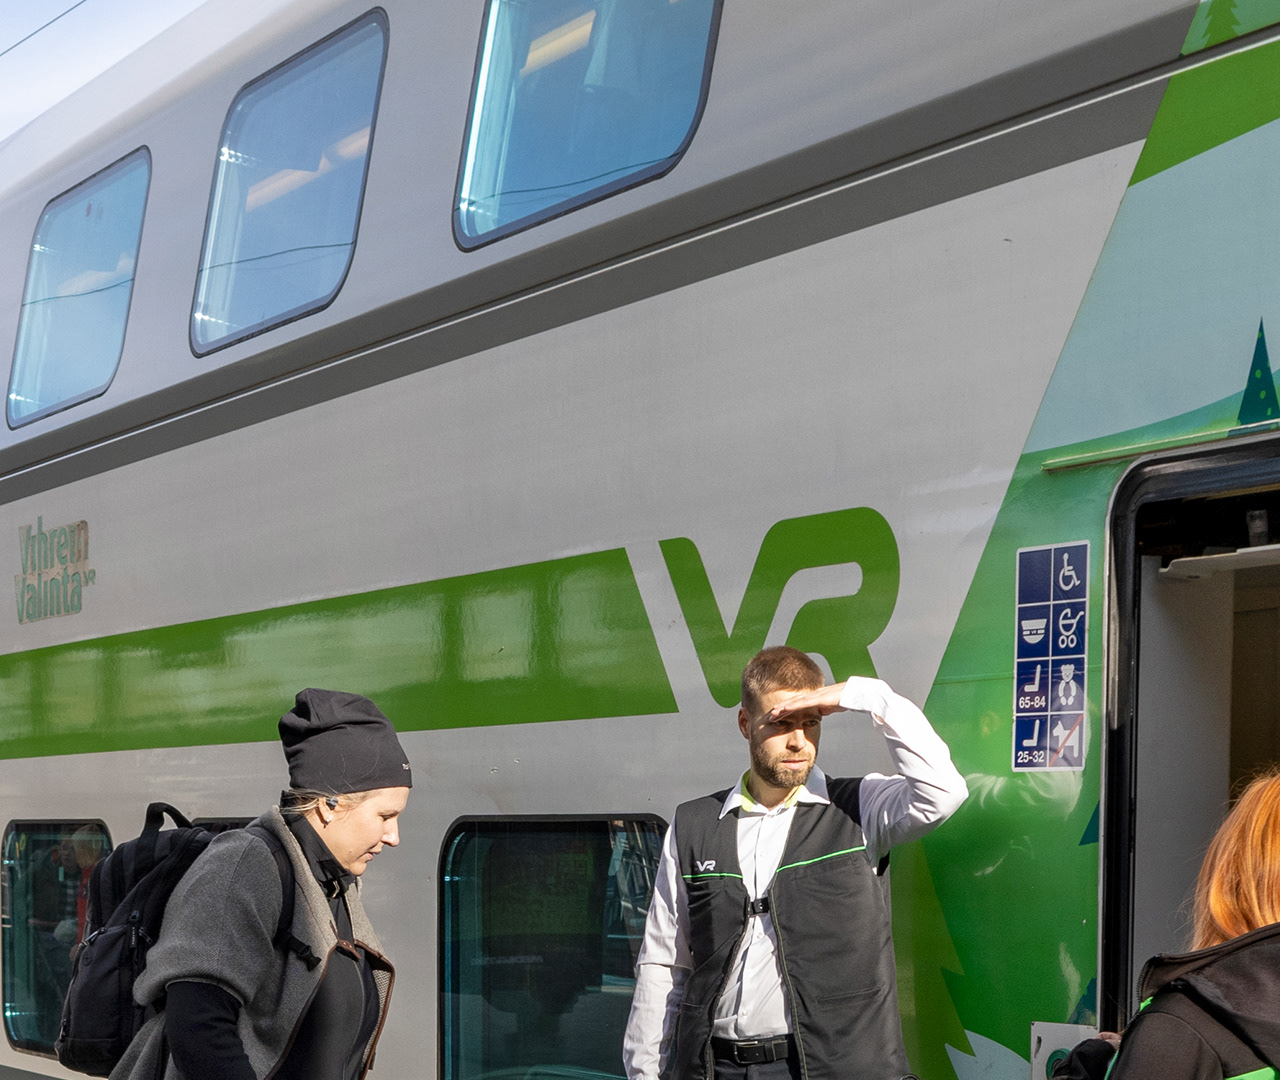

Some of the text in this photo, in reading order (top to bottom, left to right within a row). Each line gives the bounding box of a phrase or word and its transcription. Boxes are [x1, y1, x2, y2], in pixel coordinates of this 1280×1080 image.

[658, 507, 901, 709] VR
[1018, 695, 1047, 709] 65-84
[1017, 750, 1045, 763] 25-32
[696, 860, 716, 872] VR
